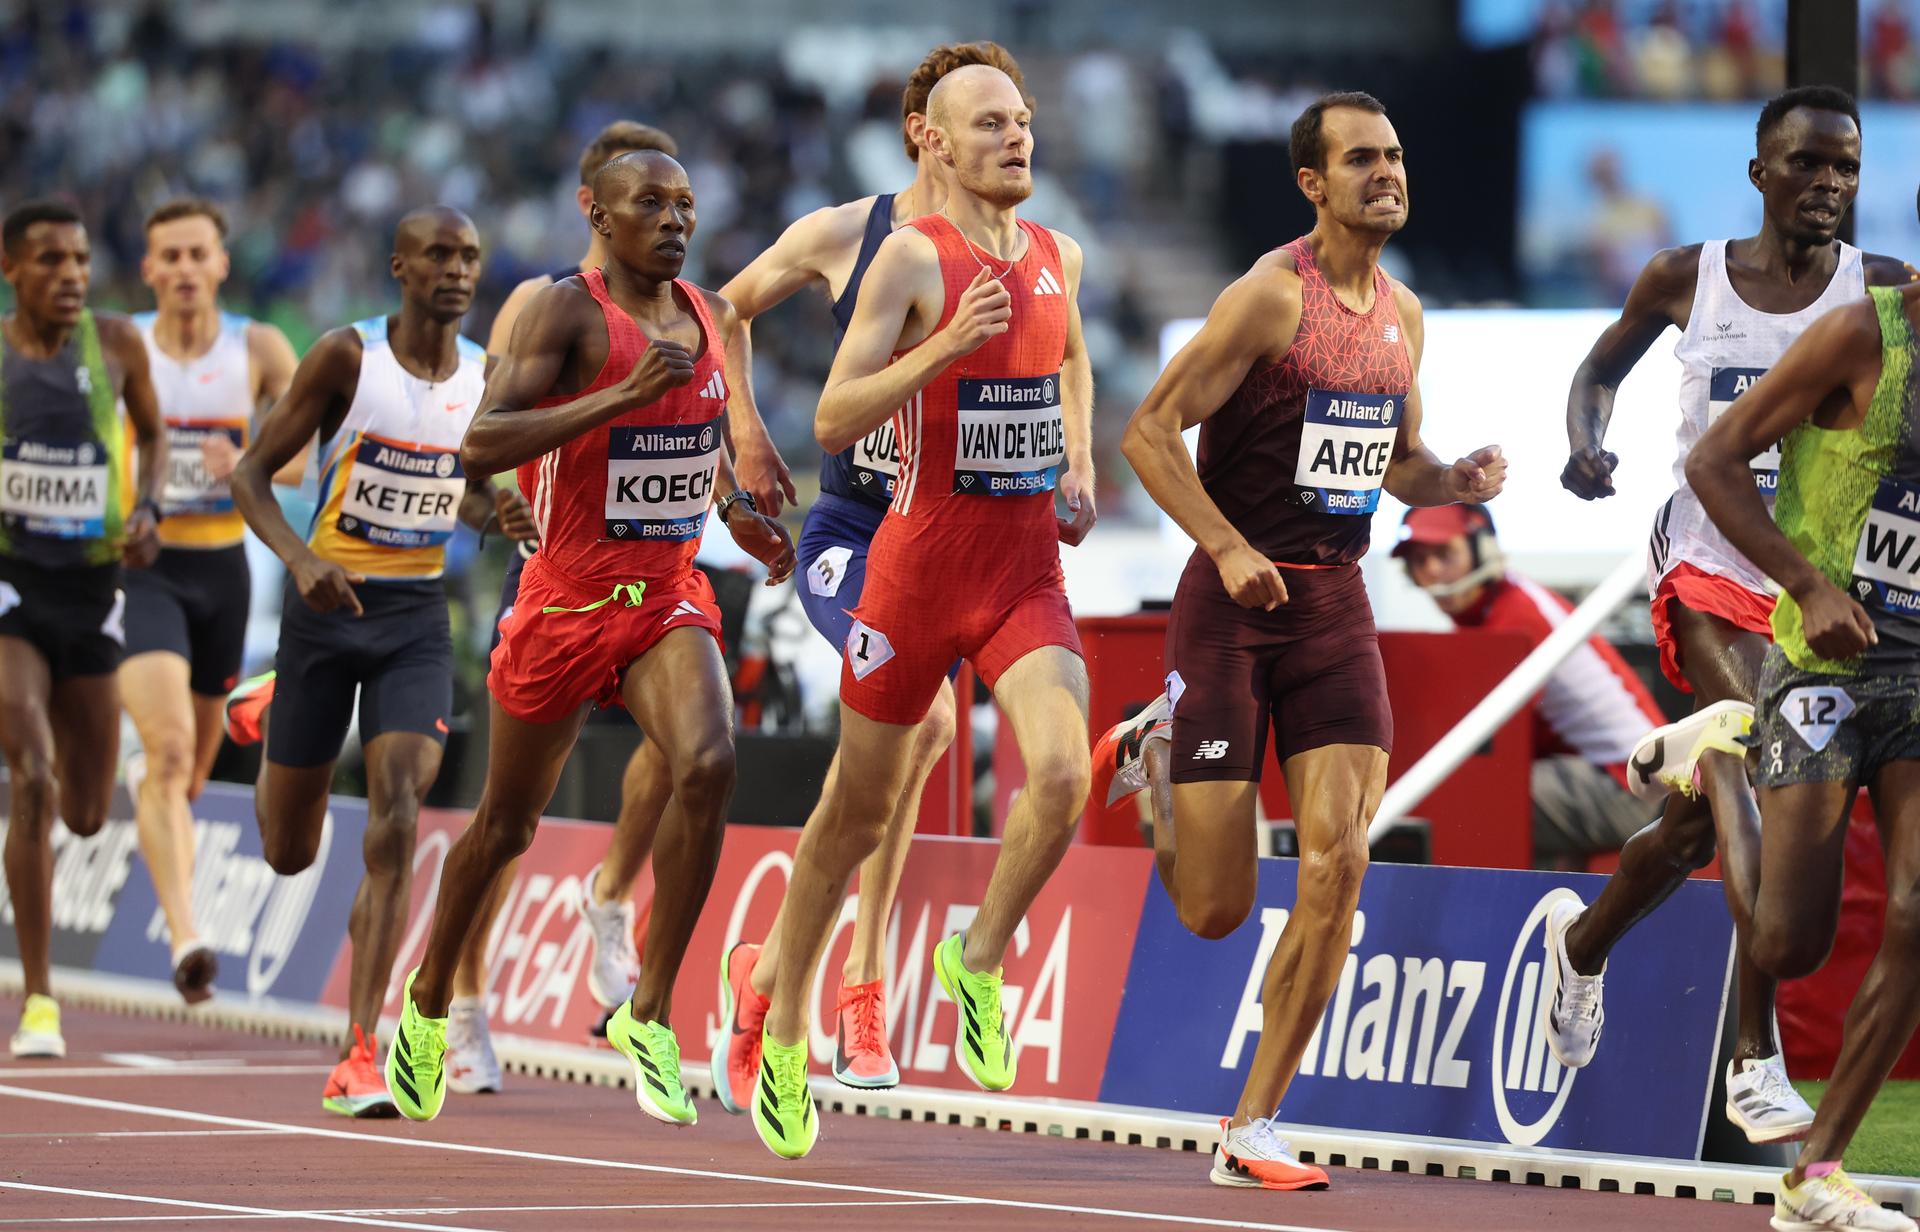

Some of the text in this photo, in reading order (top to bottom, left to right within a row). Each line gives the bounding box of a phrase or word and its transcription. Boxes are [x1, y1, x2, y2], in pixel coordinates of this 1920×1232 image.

[978, 384, 1041, 402] Allianz
[1326, 399, 1381, 421] Allianz
[632, 433, 697, 452] Allianz
[962, 418, 1064, 459] VAN DE VELDE
[374, 446, 436, 474] Allianz
[1309, 438, 1390, 477] ARCE
[7, 471, 98, 504] GIRMA
[616, 466, 715, 504] KOECH
[990, 474, 1046, 490] BRUSSELS
[1753, 474, 1778, 489] RU
[355, 480, 454, 516] KETER
[1327, 493, 1370, 509] BRUSSELS
[643, 519, 701, 537] BRUSSELS
[817, 558, 835, 587] 3
[857, 632, 869, 661] 1
[1799, 696, 1836, 725] 12
[485, 873, 596, 1029] EGA
[1220, 907, 1487, 1088] Aianz
